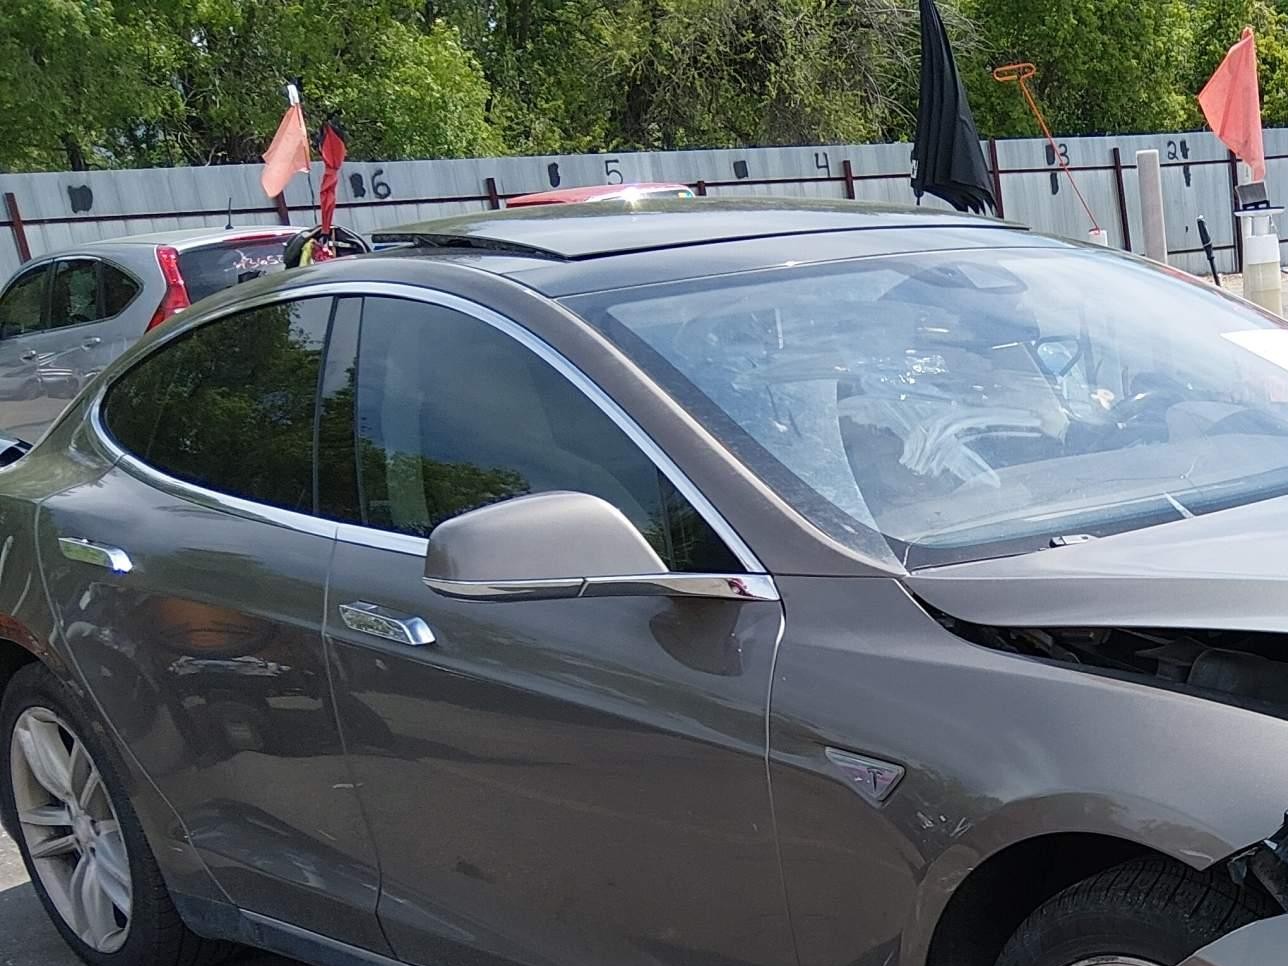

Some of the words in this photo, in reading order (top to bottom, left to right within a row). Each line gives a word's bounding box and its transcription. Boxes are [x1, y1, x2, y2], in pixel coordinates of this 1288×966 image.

[1058, 143, 1070, 167] 3
[1167, 140, 1179, 160] 2
[604, 158, 624, 186] 5
[814, 152, 831, 177] 4
[371, 168, 392, 200] 6
